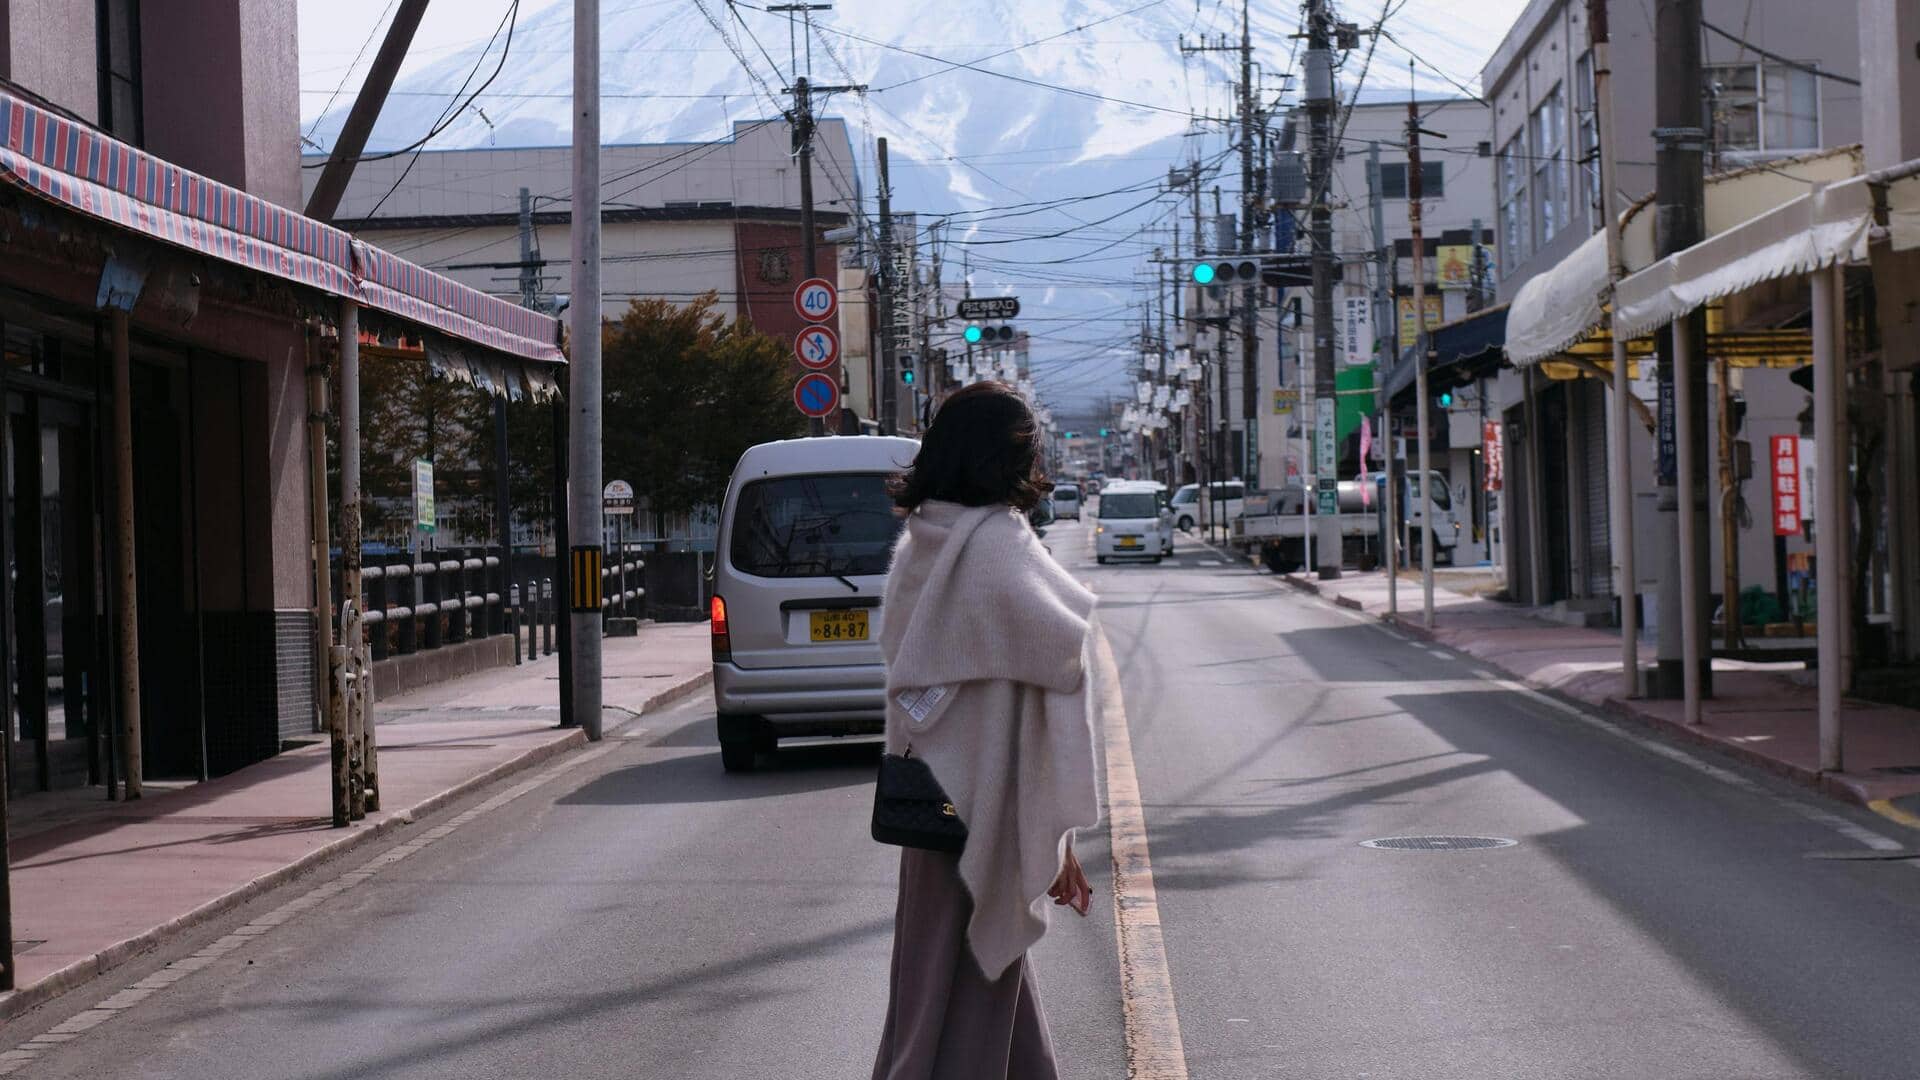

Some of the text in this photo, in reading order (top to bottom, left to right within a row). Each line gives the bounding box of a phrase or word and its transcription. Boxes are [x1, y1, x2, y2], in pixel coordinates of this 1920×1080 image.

[804, 290, 828, 312] 40
[1777, 438, 1796, 530] 月極駐車場
[824, 622, 865, 638] 84-87
